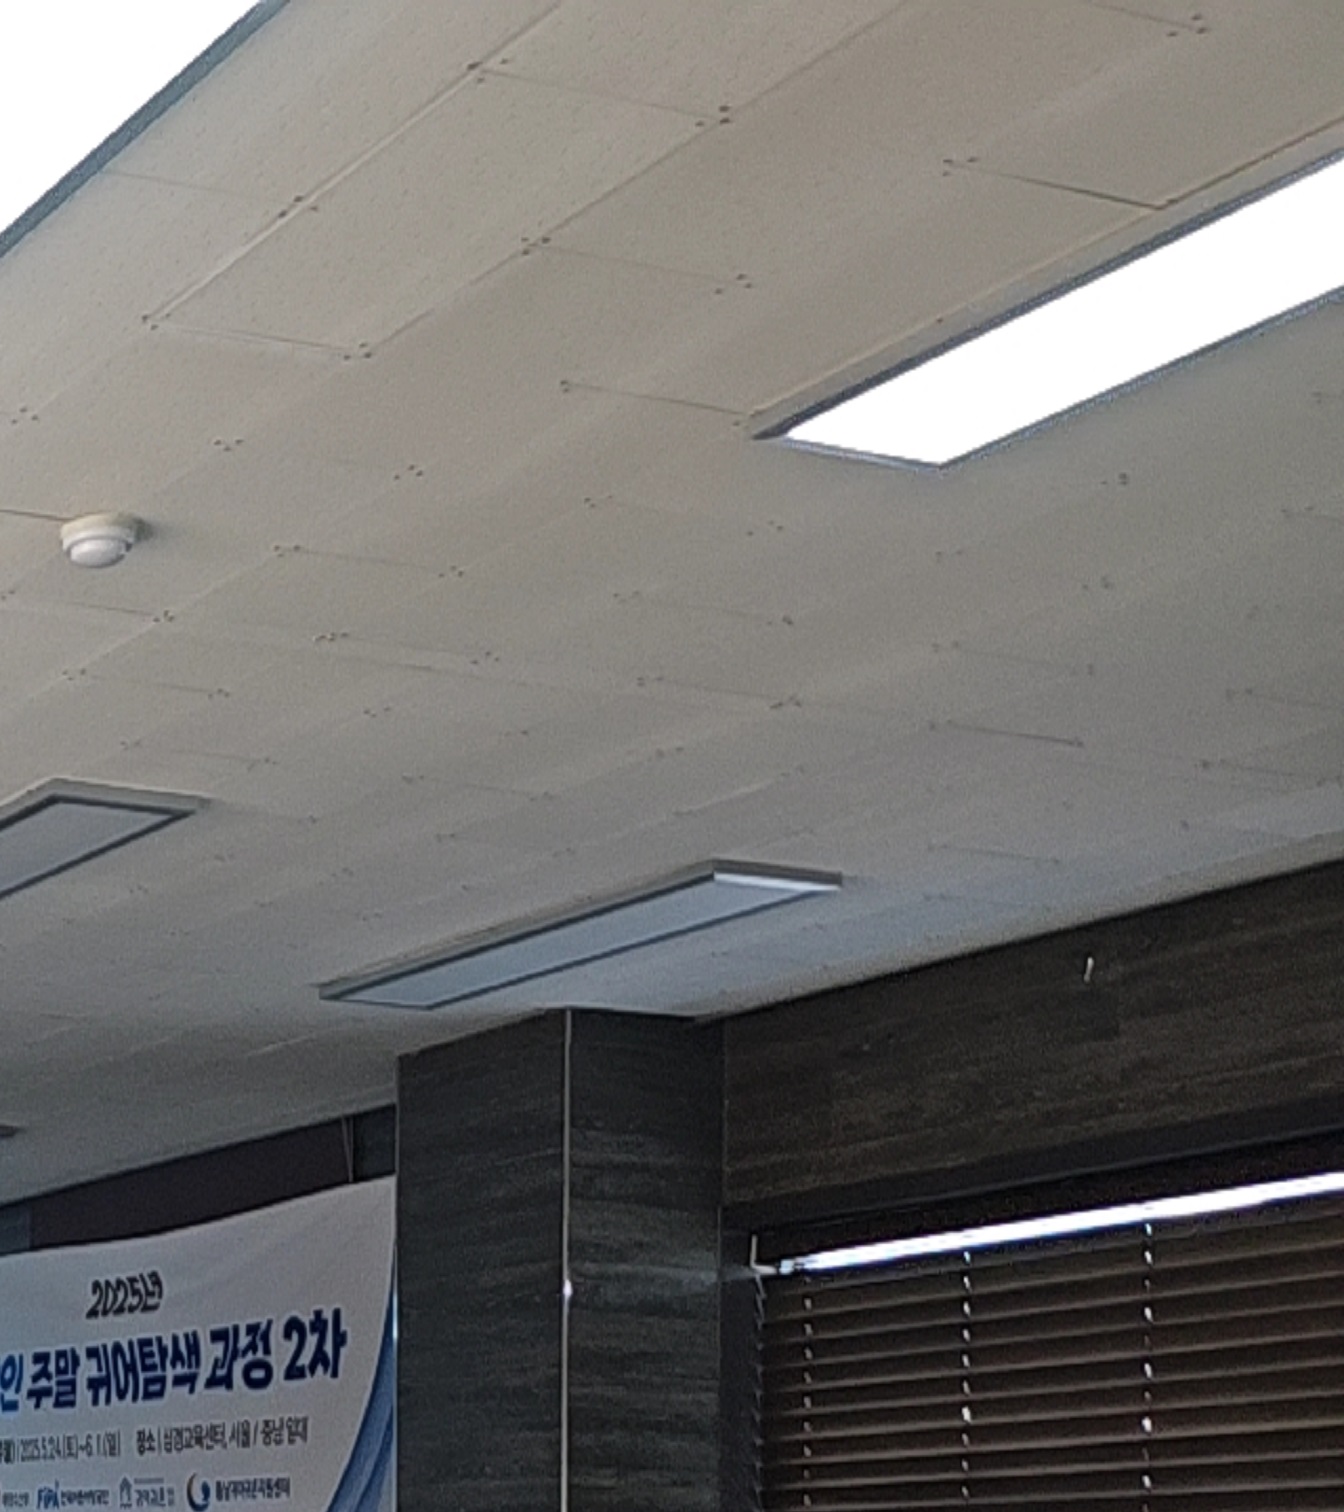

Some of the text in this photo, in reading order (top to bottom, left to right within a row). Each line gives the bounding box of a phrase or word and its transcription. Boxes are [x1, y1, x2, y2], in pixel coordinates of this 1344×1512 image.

[86, 1270, 163, 1319] 2025년
[27, 1347, 80, 1409] 주말
[85, 1330, 202, 1407] 귀어탐색
[204, 1319, 274, 1390] 과정
[283, 1307, 348, 1381] 2차
